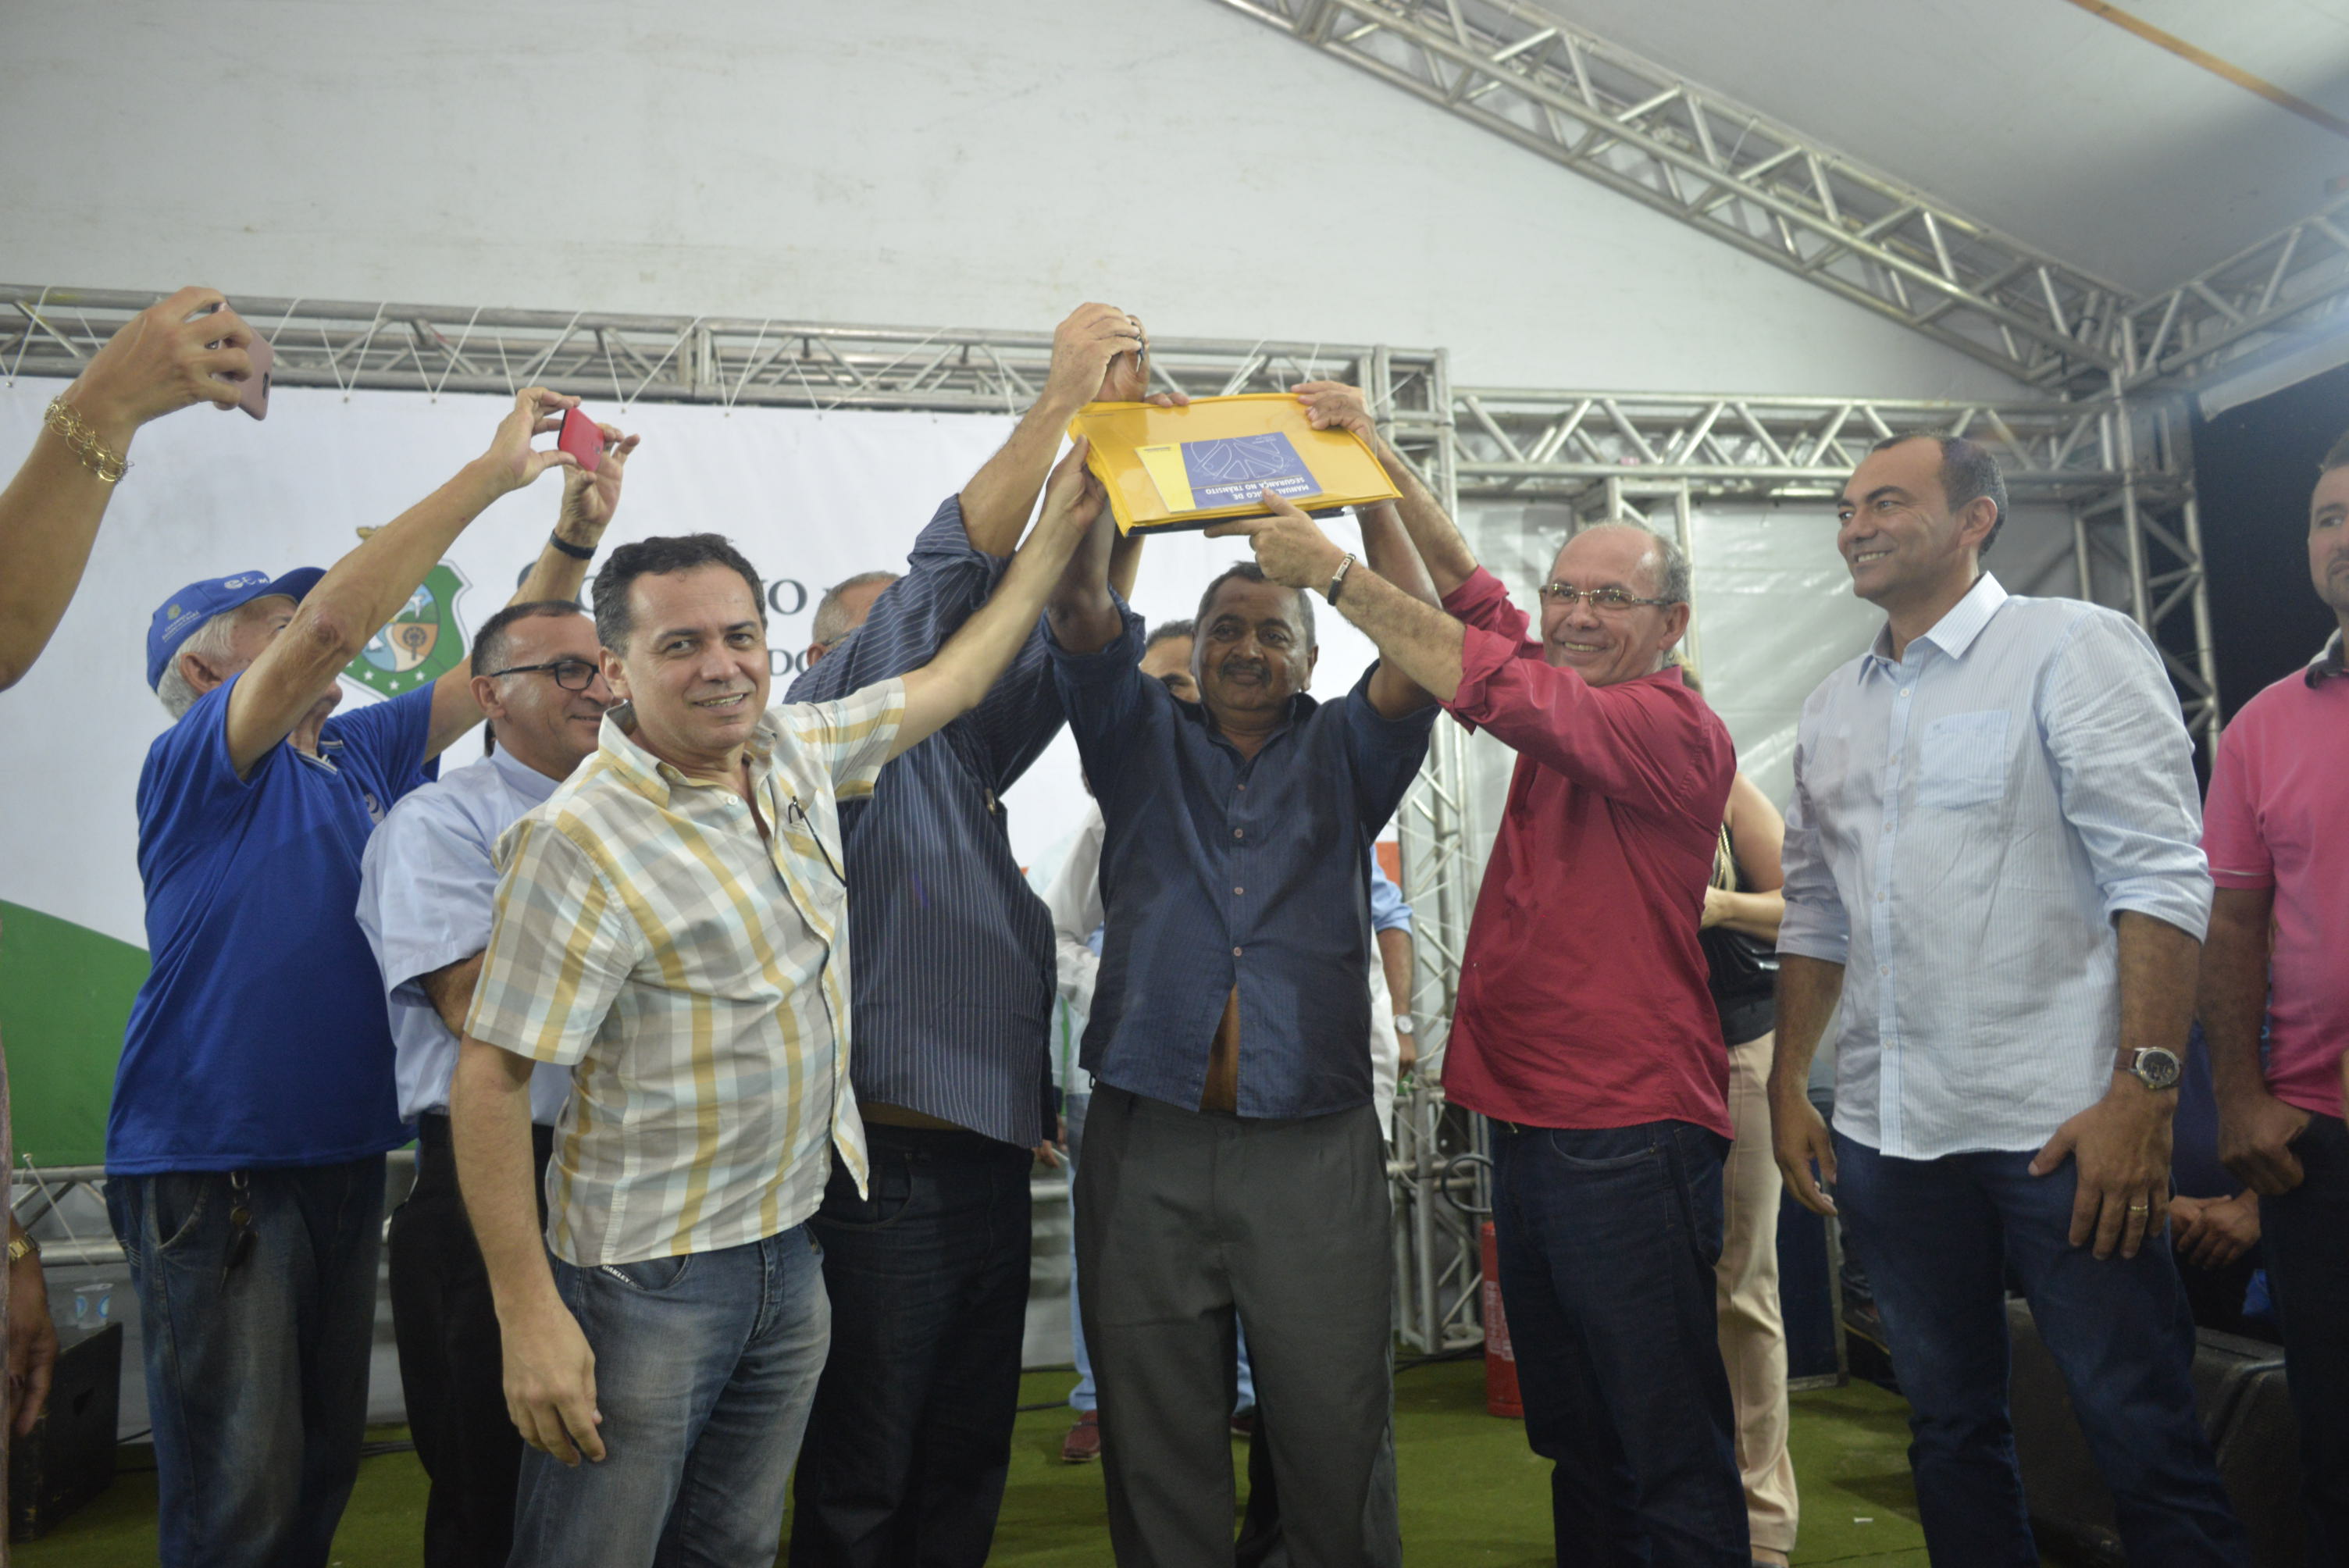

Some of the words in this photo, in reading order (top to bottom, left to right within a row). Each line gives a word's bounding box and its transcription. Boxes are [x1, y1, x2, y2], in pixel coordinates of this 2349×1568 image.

[1258, 476, 1306, 489] SEGURANÇA
[1205, 485, 1244, 495] TRÂNSITO
[1276, 484, 1310, 494] MANUAL
